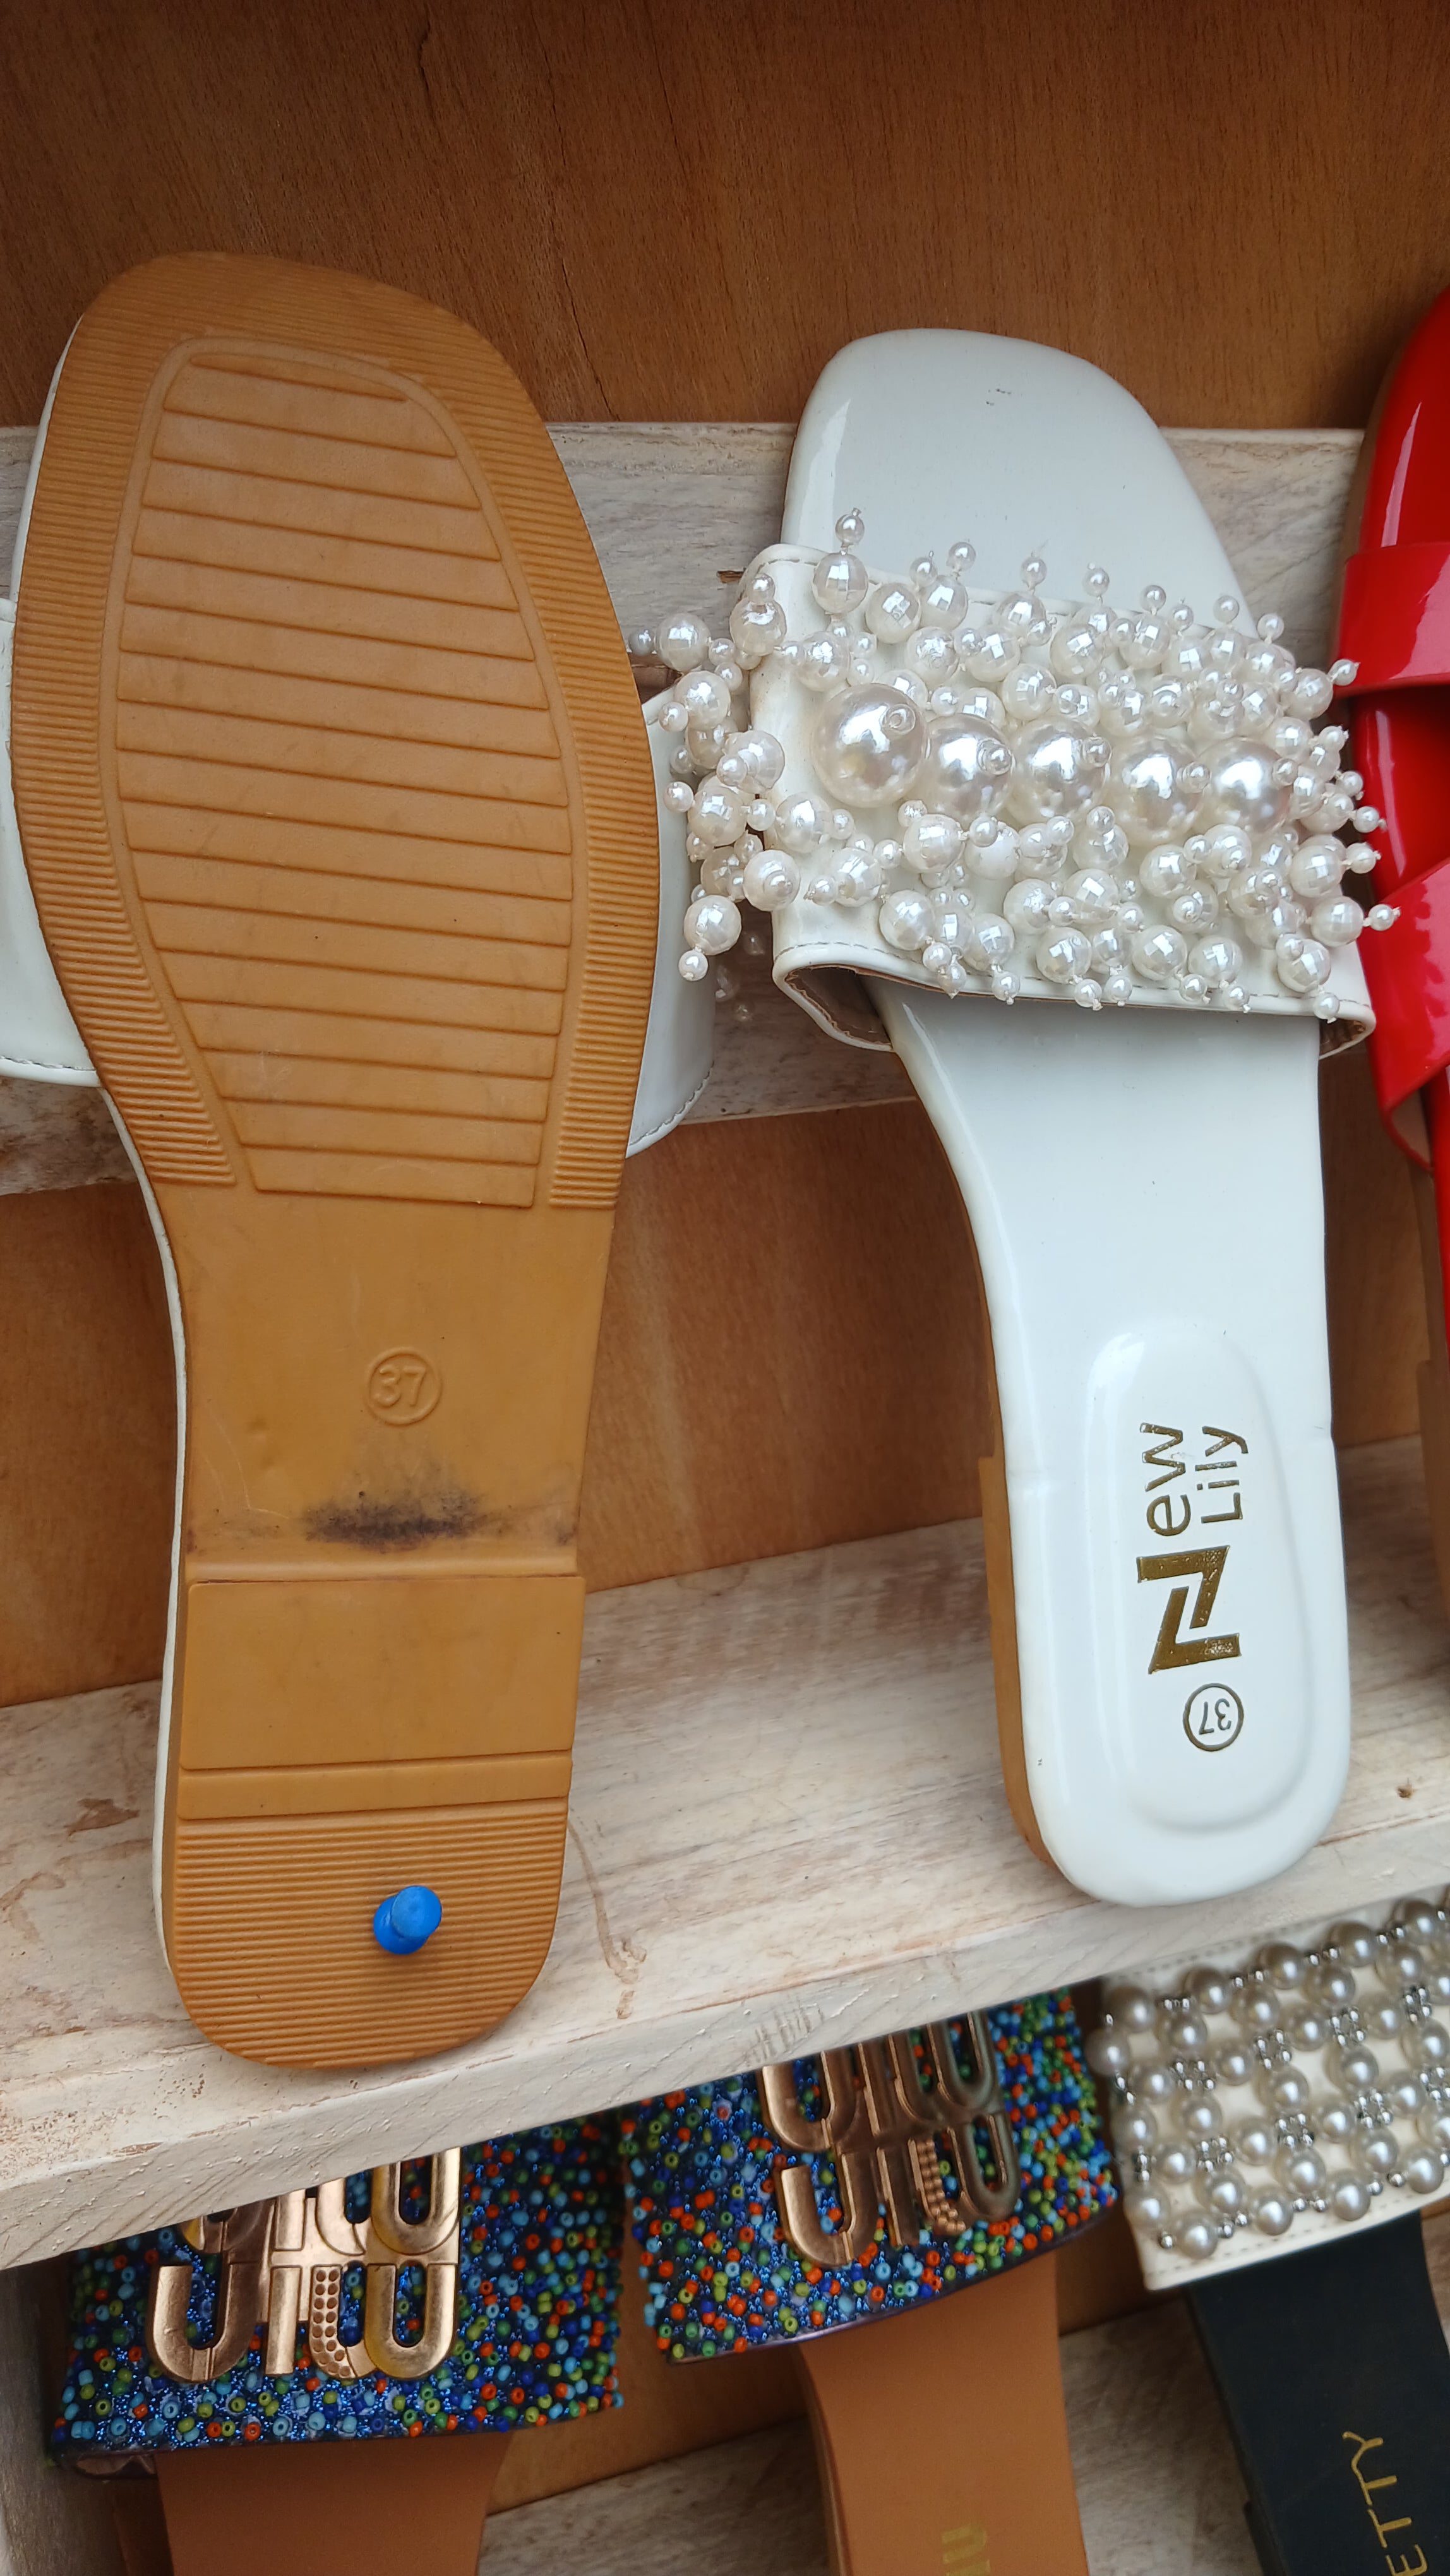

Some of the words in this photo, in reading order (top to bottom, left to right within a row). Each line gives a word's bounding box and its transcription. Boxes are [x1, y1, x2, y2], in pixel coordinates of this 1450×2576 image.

[375, 1364, 428, 1409] 37
[1195, 1425, 1249, 1524] Lily
[1198, 1698, 1232, 1735] 37
